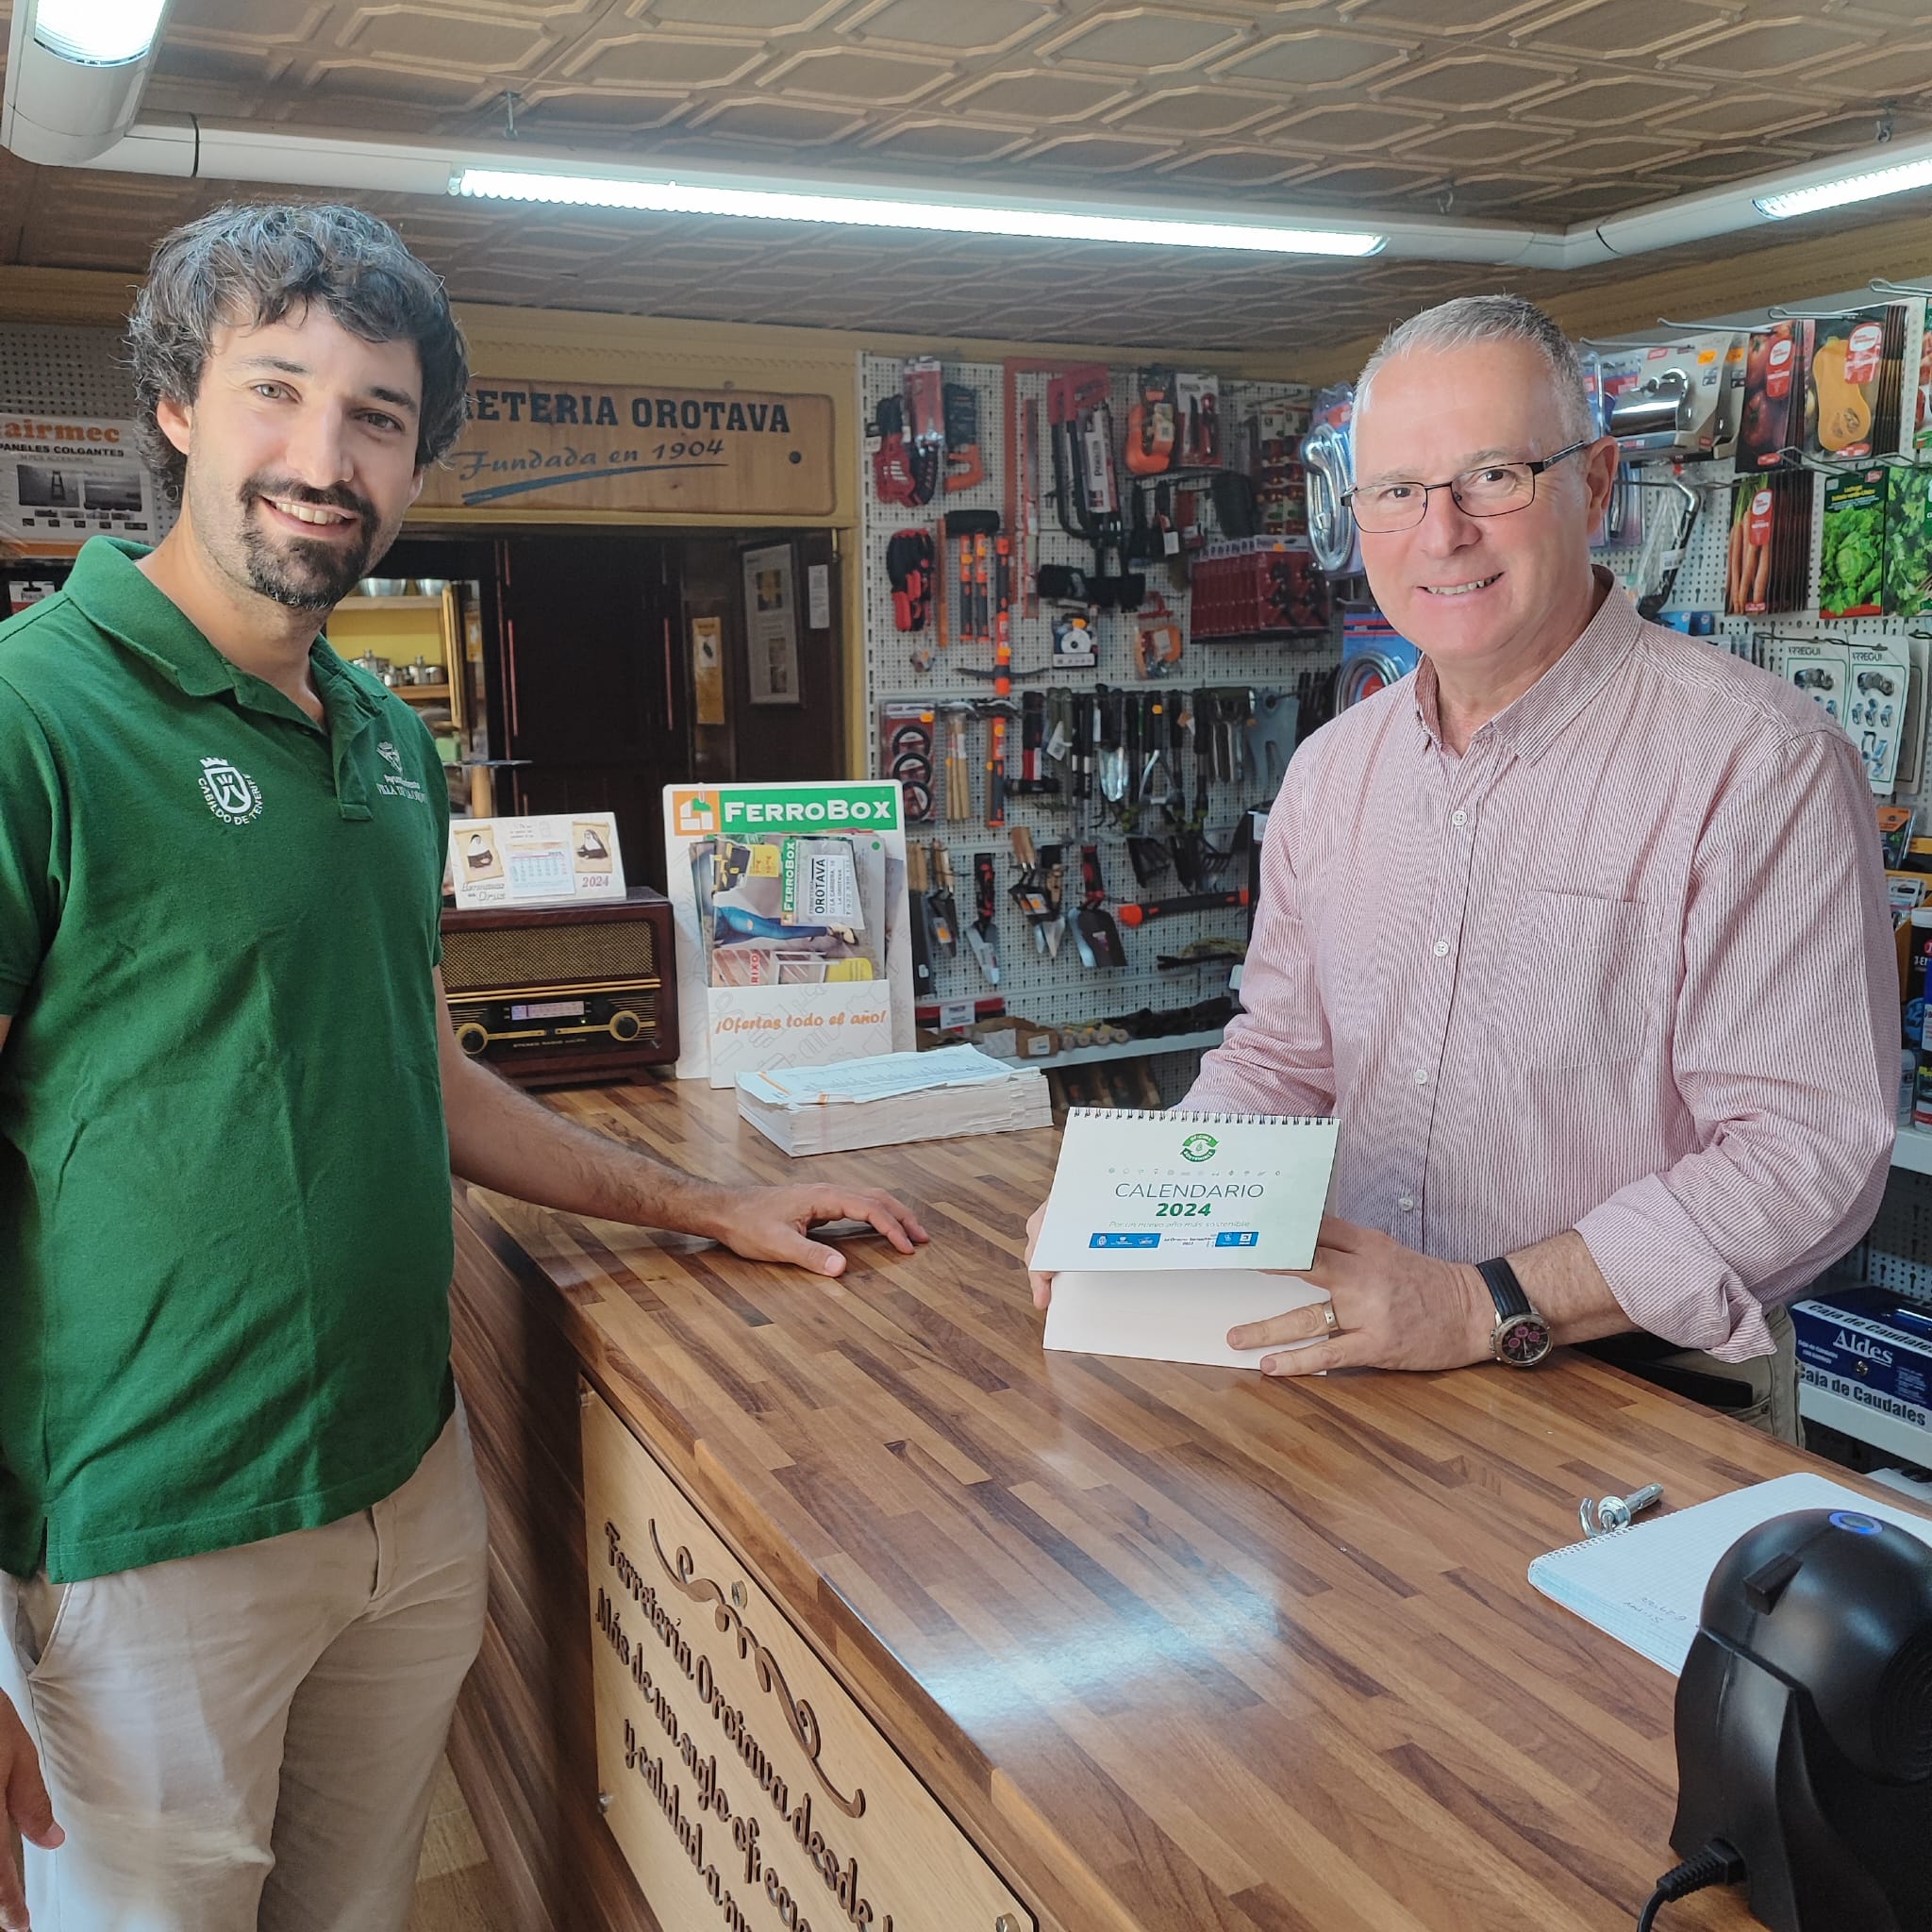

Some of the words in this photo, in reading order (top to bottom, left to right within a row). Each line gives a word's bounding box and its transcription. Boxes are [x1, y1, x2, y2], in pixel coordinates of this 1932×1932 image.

[468, 390, 619, 426] ETERIA
[631, 397, 791, 433] OROTAVA
[53, 445, 125, 458] COLGANTES
[450, 446, 597, 481] Fundada
[608, 448, 638, 462] en
[651, 439, 724, 460] 1904
[198, 776, 232, 824] CABILDO
[234, 815, 250, 825] DE
[581, 874, 609, 889] 2024
[814, 858, 825, 914] OROTAVA
[714, 1015, 782, 1034] ¡Ofertas
[786, 1012, 824, 1028] todo
[828, 1011, 845, 1025] el
[850, 1009, 888, 1024] año!
[1115, 1182, 1265, 1199] CALENDARIO
[1155, 1202, 1212, 1217] 2024
[1808, 1304, 1840, 1320] Caja
[1843, 1316, 1864, 1327] de
[1833, 1329, 1894, 1365] Aldes
[1831, 1378, 1850, 1397] de
[1853, 1386, 1926, 1427] Caudales
[595, 1586, 630, 1666] Más
[630, 1642, 655, 1704] de
[654, 1687, 681, 1747] un
[680, 1732, 733, 1823] siglo
[604, 1522, 695, 1680] Ferretería
[696, 1655, 791, 1822] Orotava
[791, 1792, 873, 1932] desde
[624, 1718, 638, 1770] y
[638, 1746, 706, 1875] calidad
[705, 1864, 724, 1907] a
